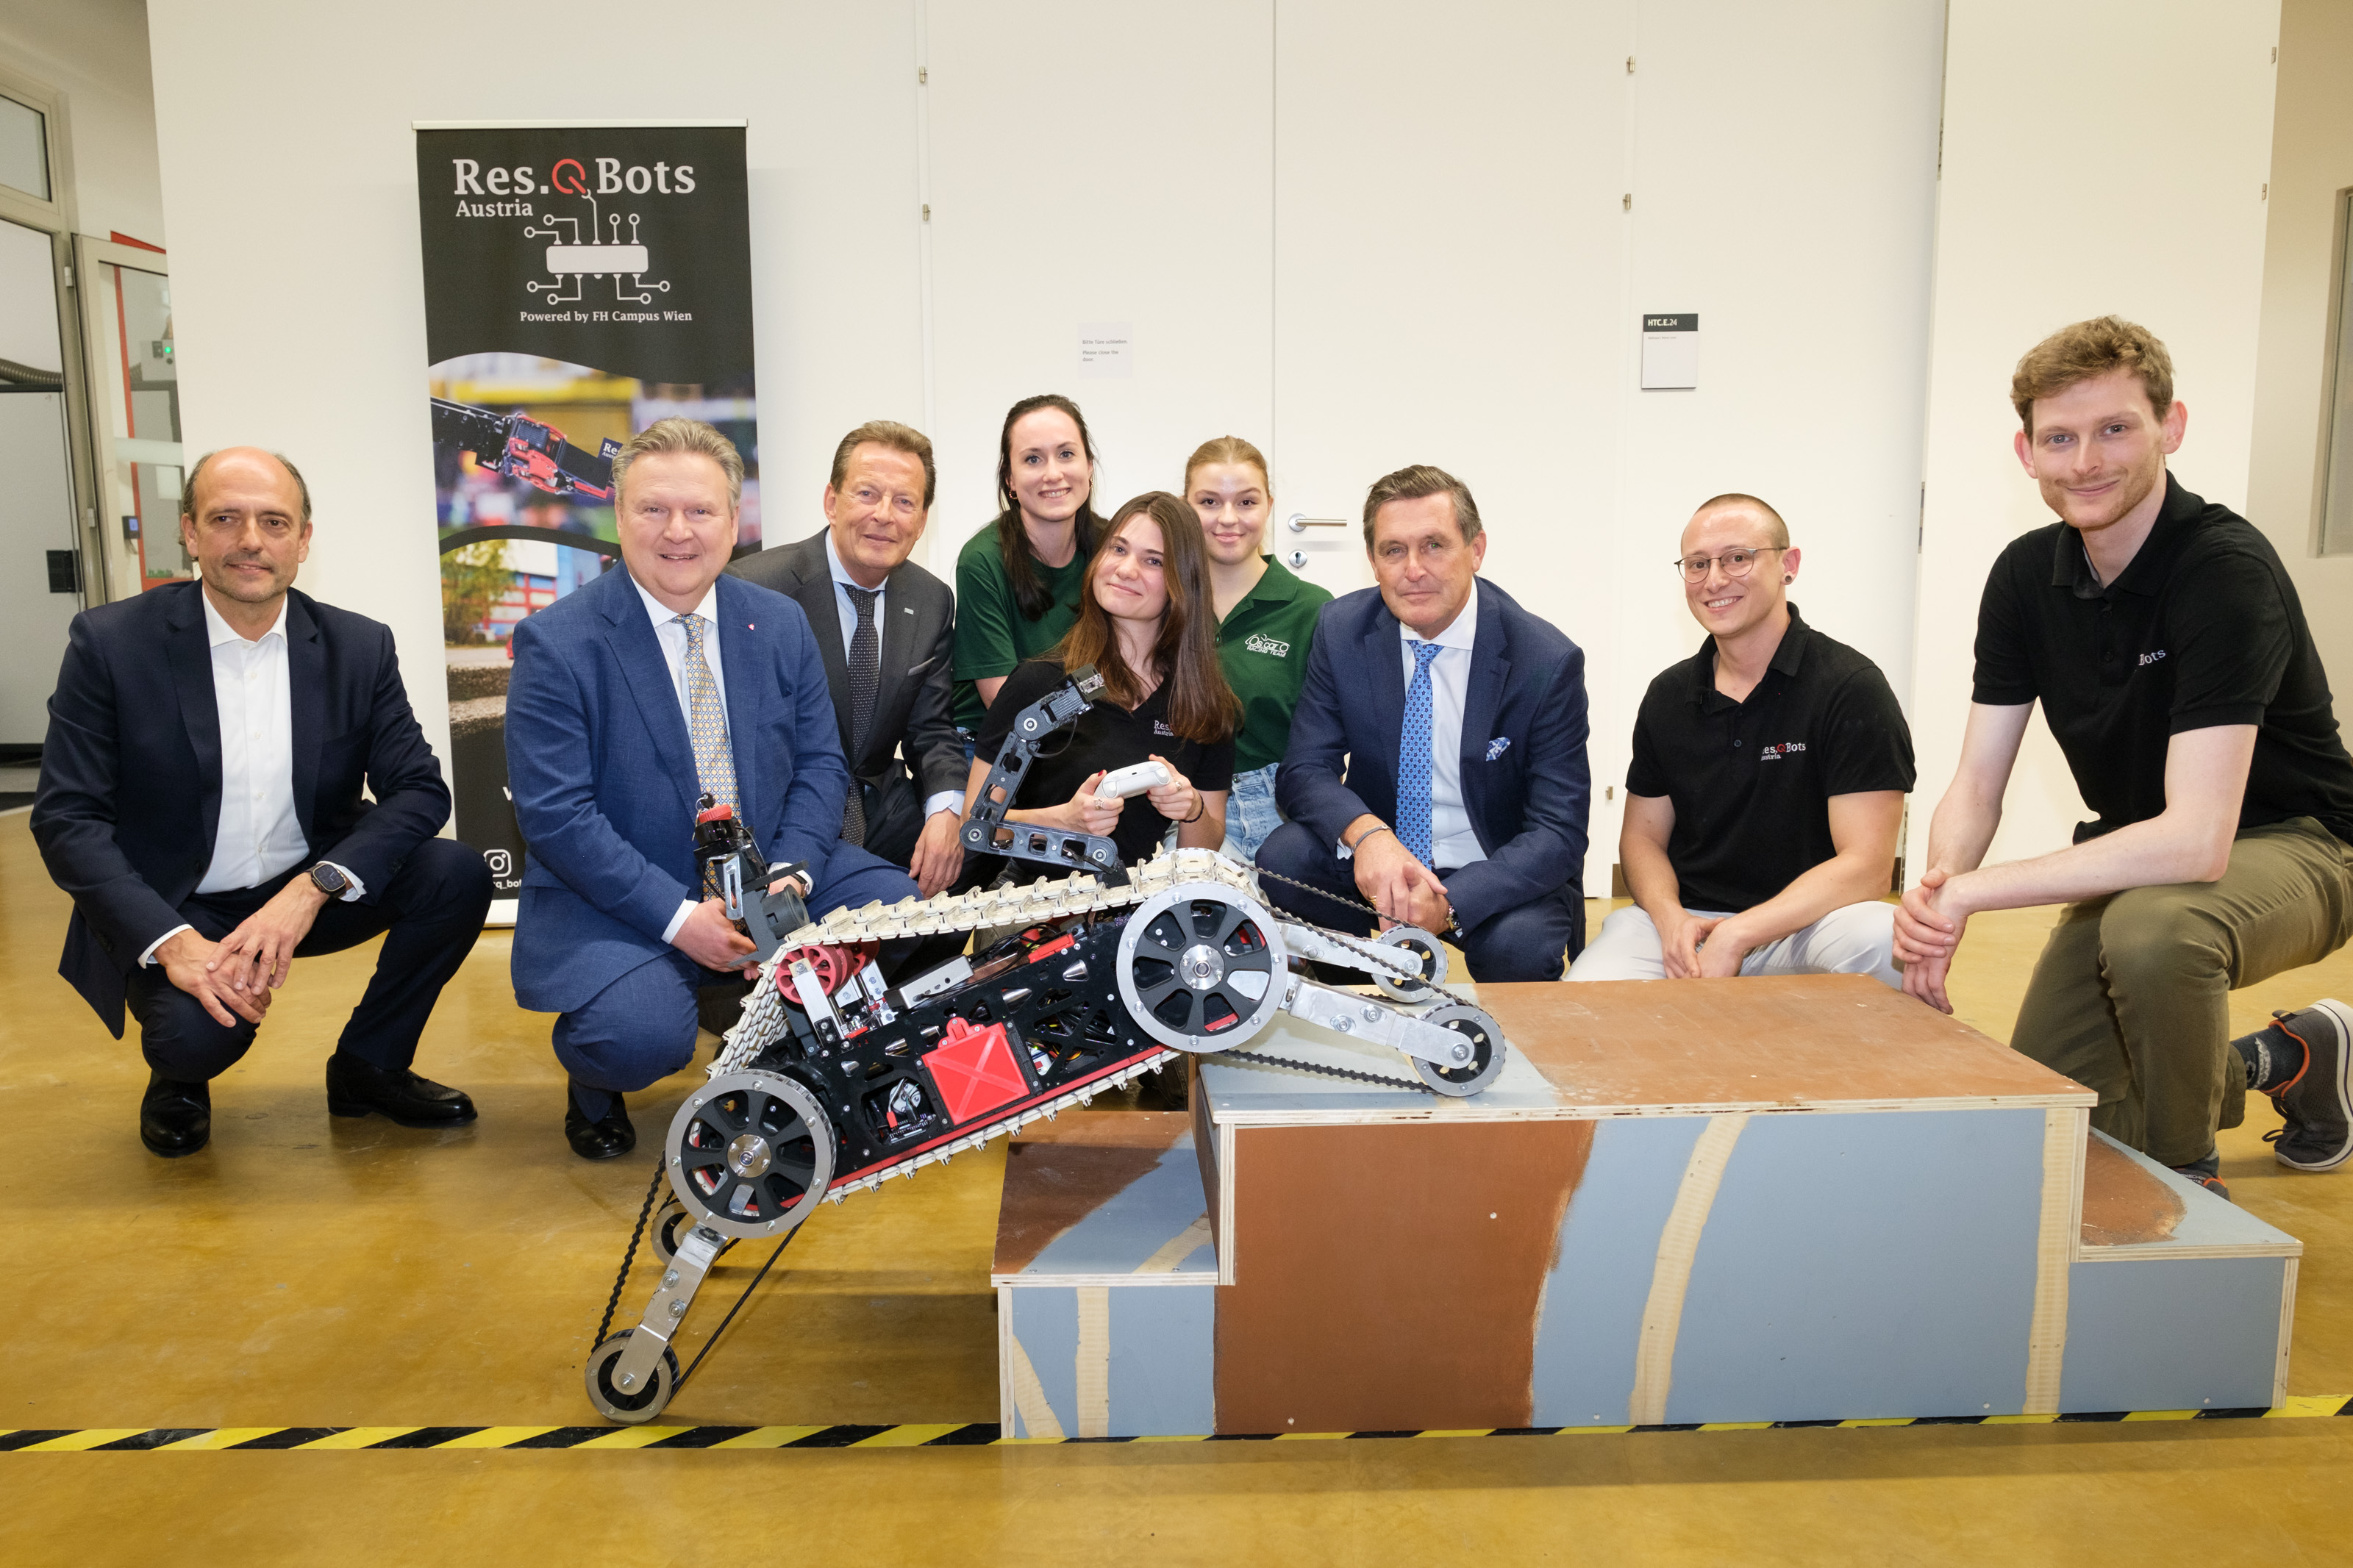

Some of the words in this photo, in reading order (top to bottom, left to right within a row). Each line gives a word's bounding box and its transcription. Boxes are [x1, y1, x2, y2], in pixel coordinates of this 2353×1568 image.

[455, 198, 533, 218] Austria
[520, 311, 571, 322] Powered
[574, 311, 589, 323] by
[593, 311, 609, 321] FH
[612, 311, 660, 323] Campus
[663, 310, 693, 321] Wien
[1246, 645, 1268, 654] RACING
[1270, 650, 1287, 658] TEAM
